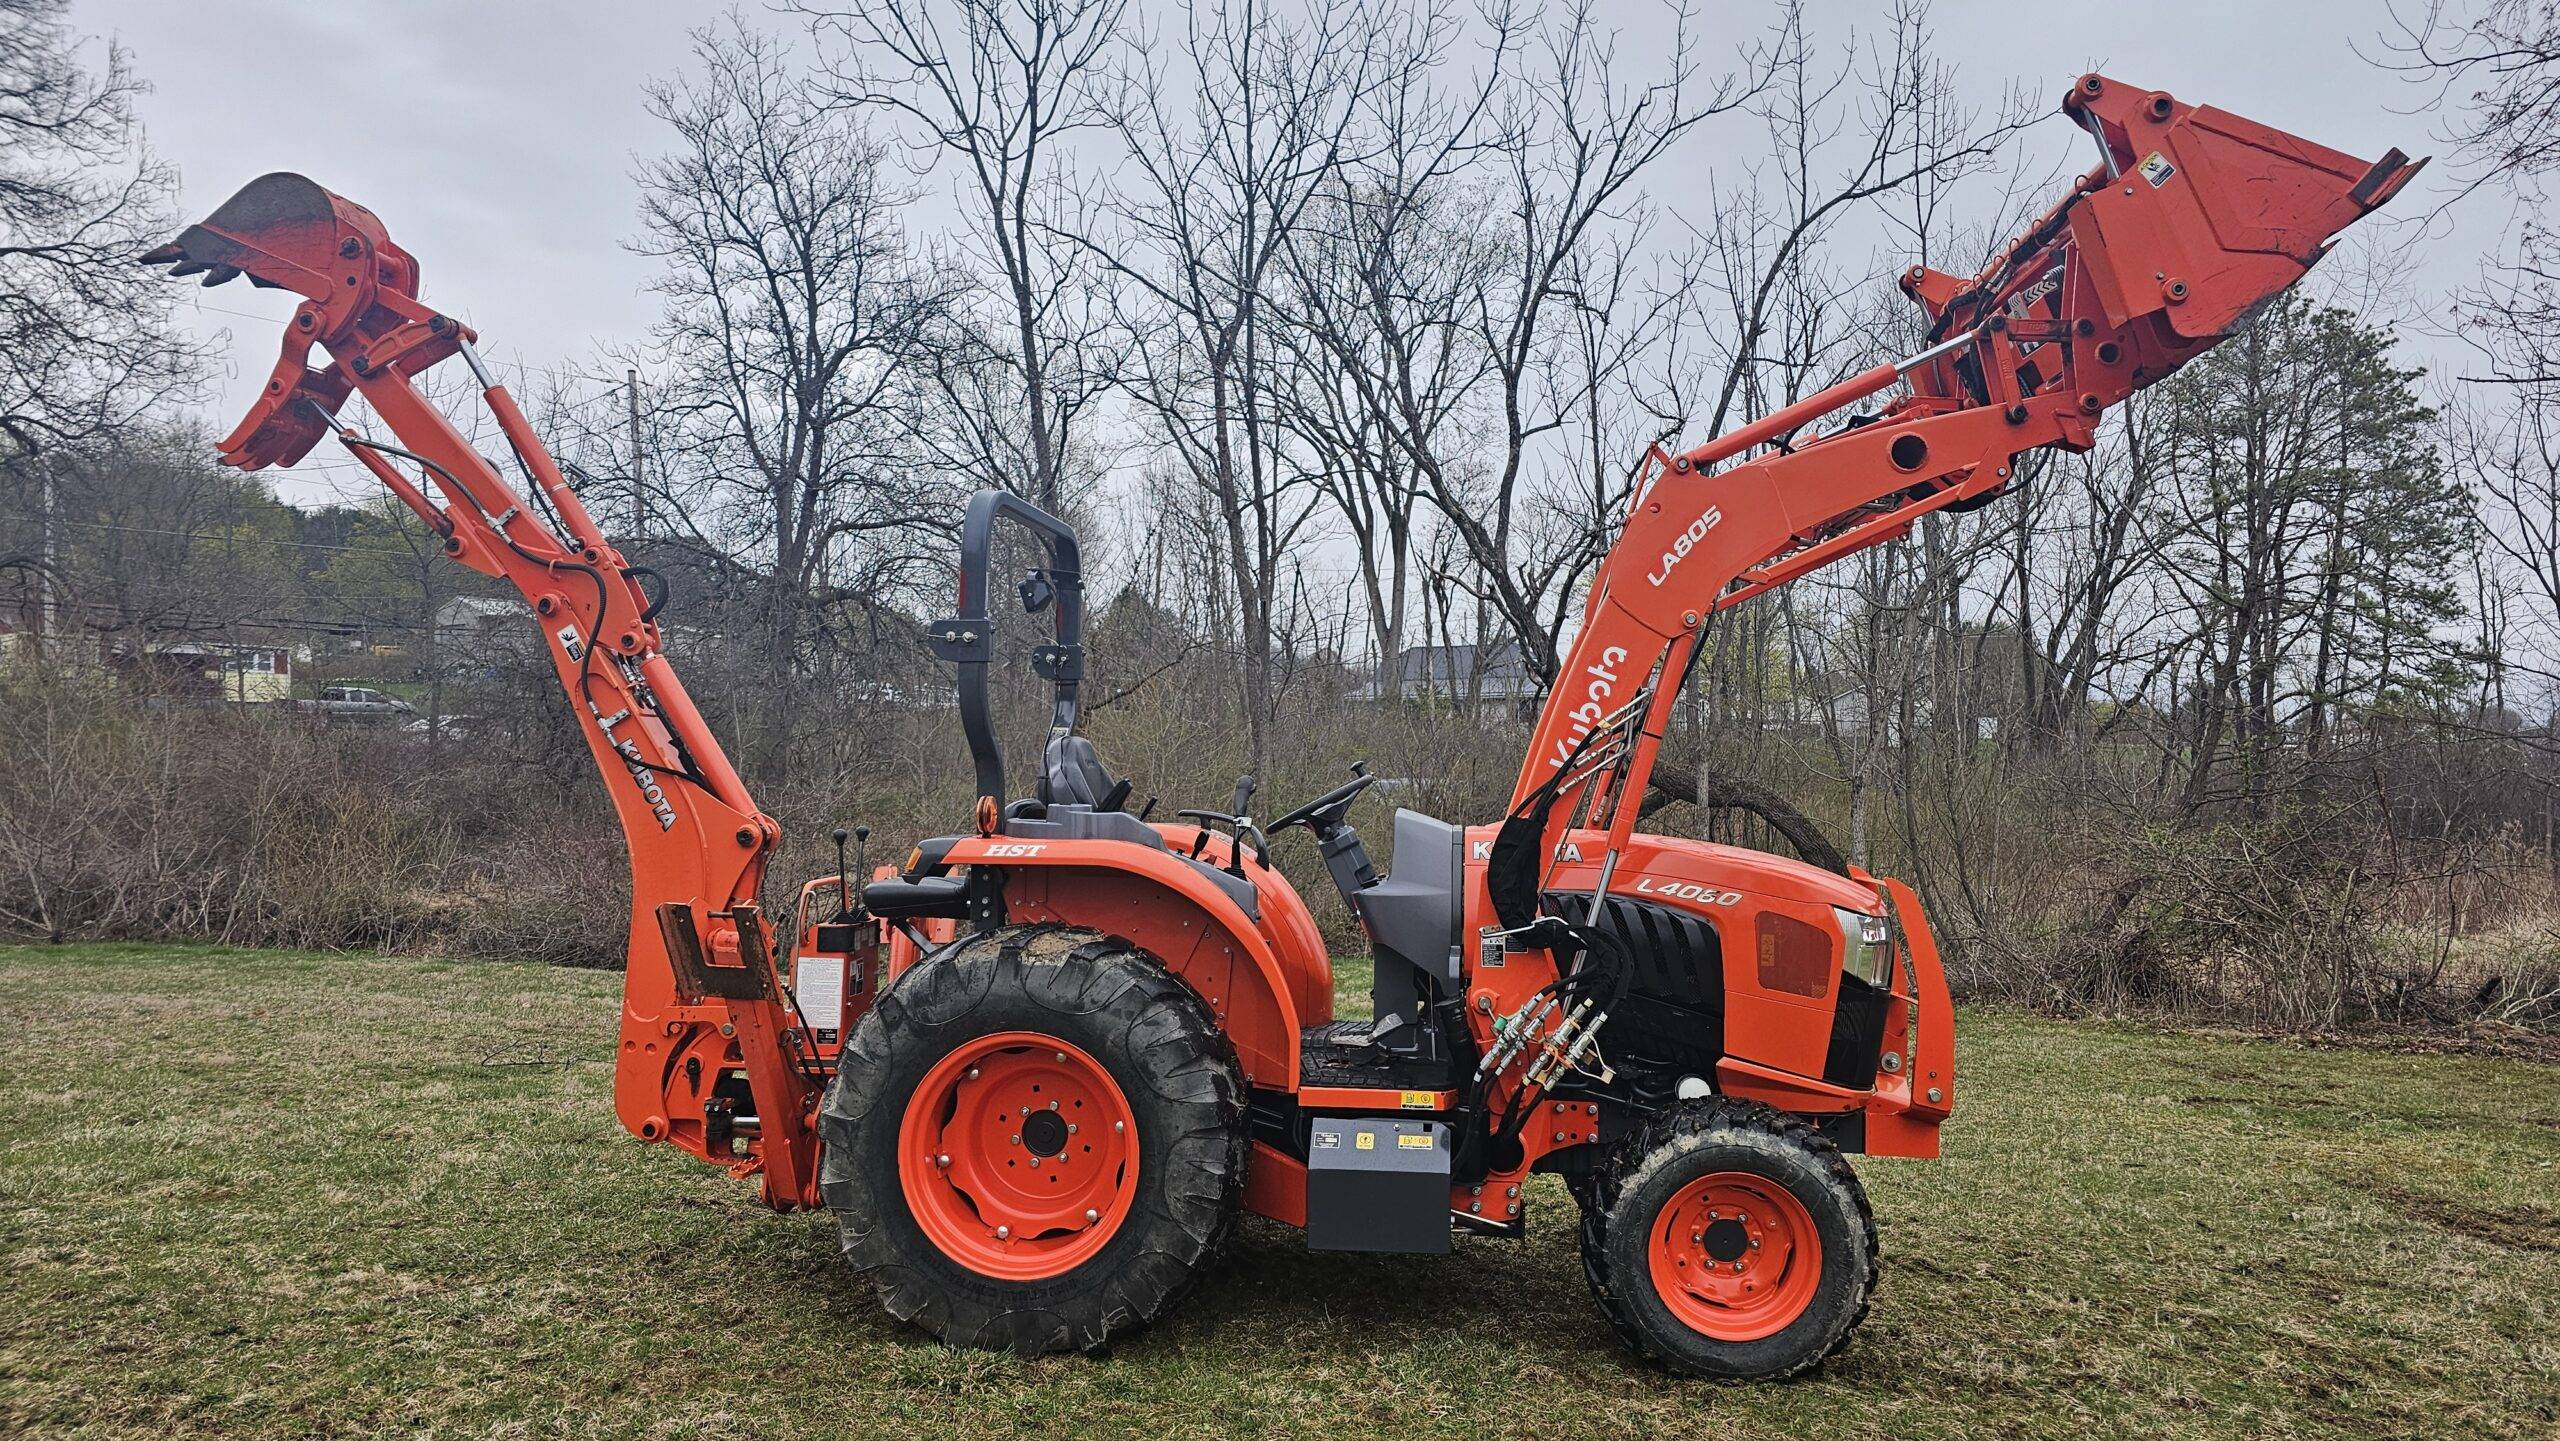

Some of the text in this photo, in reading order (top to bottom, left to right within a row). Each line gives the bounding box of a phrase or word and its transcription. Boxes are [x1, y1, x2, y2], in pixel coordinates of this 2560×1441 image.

[1647, 504, 1723, 588] LA805
[982, 844, 1047, 857] HST
[1636, 878, 1743, 907] L4060
